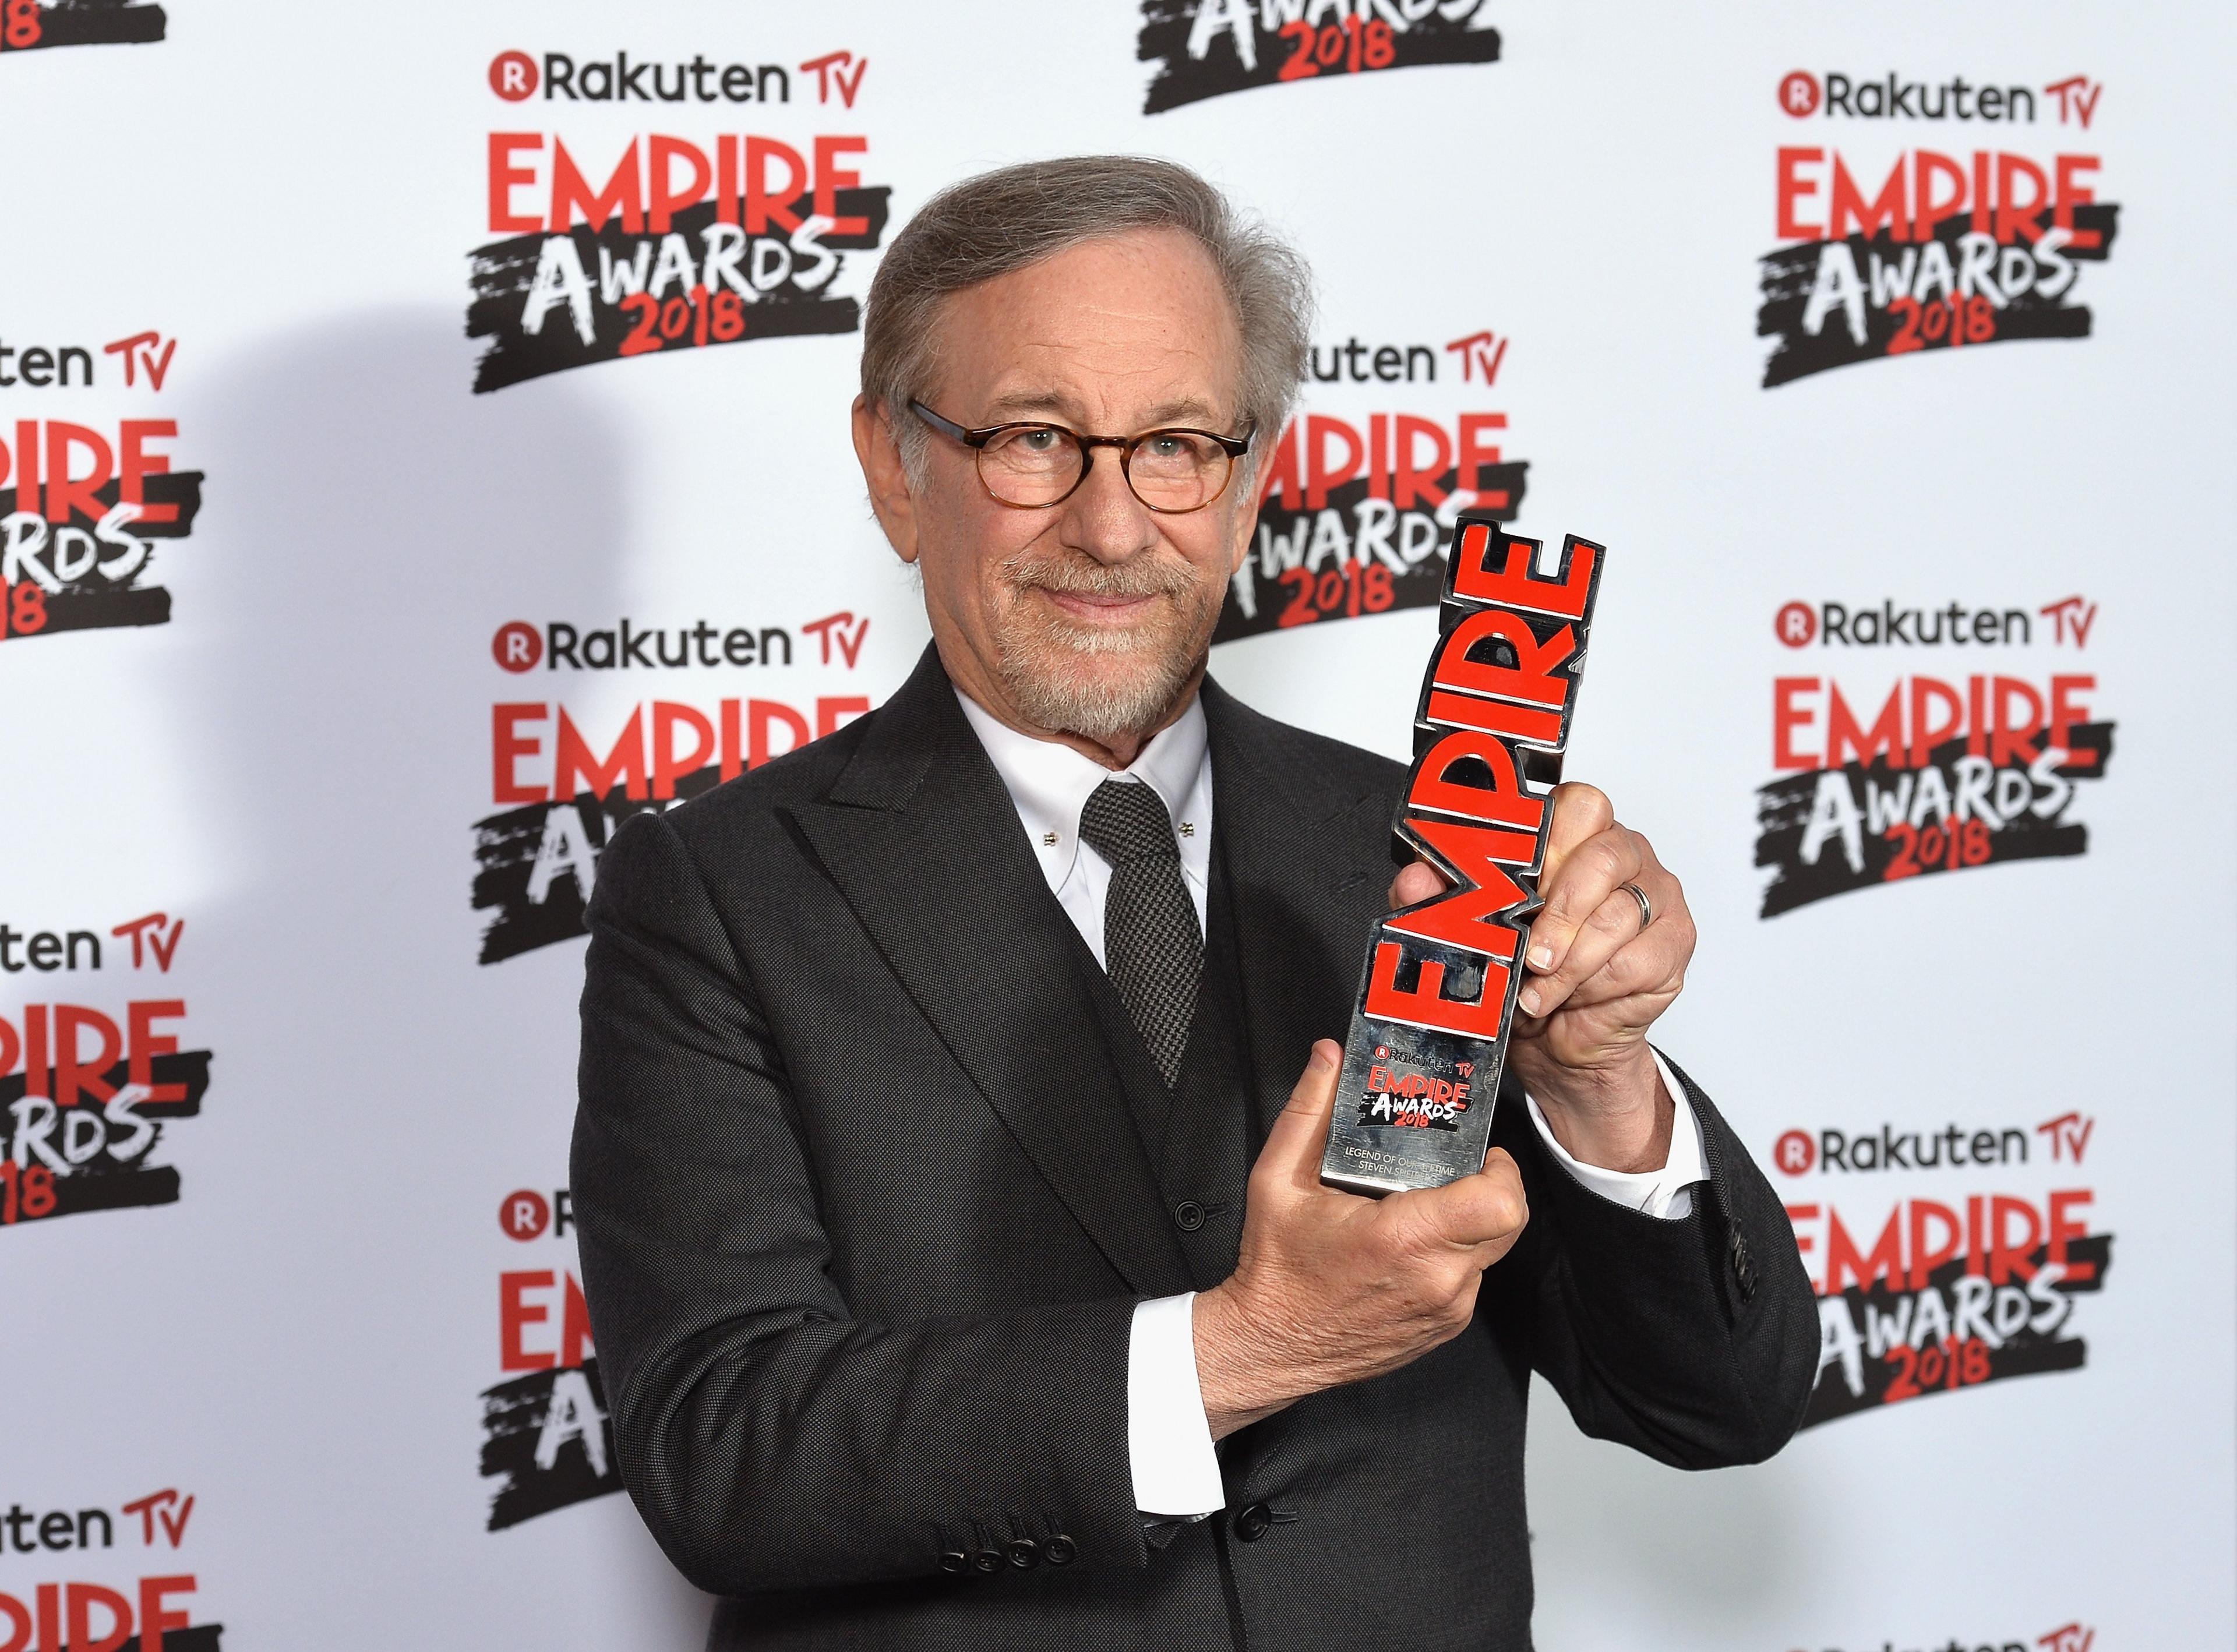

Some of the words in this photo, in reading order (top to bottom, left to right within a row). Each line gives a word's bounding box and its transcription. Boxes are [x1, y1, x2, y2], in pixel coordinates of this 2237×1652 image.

[1278, 13, 1396, 81] 2018
[544, 51, 789, 102] Rakuten
[800, 51, 867, 108] TV
[1825, 72, 2035, 122] Rakuten
[2044, 75, 2101, 129] TV
[488, 132, 869, 234] EMPIRE
[1776, 146, 2102, 248] EMPIRE
[521, 215, 839, 347] AWARDS
[1803, 227, 2075, 345] AWARDS
[619, 284, 744, 357] 2018
[1887, 290, 1995, 356] 2018
[104, 331, 177, 392] TV
[1446, 331, 1508, 386] TV
[1278, 557, 1395, 627] 2018
[1822, 599, 2030, 647] Rakuten
[2040, 595, 2097, 648] TV
[547, 619, 791, 670] Rakuten
[802, 612, 869, 669] TV
[1773, 675, 2098, 769] EMPIRE
[1365, 524, 1597, 1041] EMPIRE
[1800, 748, 2070, 873] AWARDS
[1884, 813, 1991, 881] 2018
[111, 913, 184, 972] TV
[1368, 1065, 1470, 1109] EMPIRE
[1389, 1049, 1453, 1074] Rakuten
[1455, 1062, 1474, 1078] TV
[1371, 1093, 1458, 1121] AWARDS
[1394, 1111, 1429, 1128] 2018
[1345, 1146, 1381, 1161] LEGEND
[1383, 1155, 1396, 1164] OF
[1359, 1160, 1392, 1174] STEVEN
[1820, 1124, 2027, 1172] Rakuten
[2037, 1111, 2093, 1163] TV
[0, 1159, 57, 1224] 18
[1813, 1264, 2067, 1396] AWARDS
[1883, 1335, 1990, 1404] 2018
[122, 1488, 194, 1549] TV
